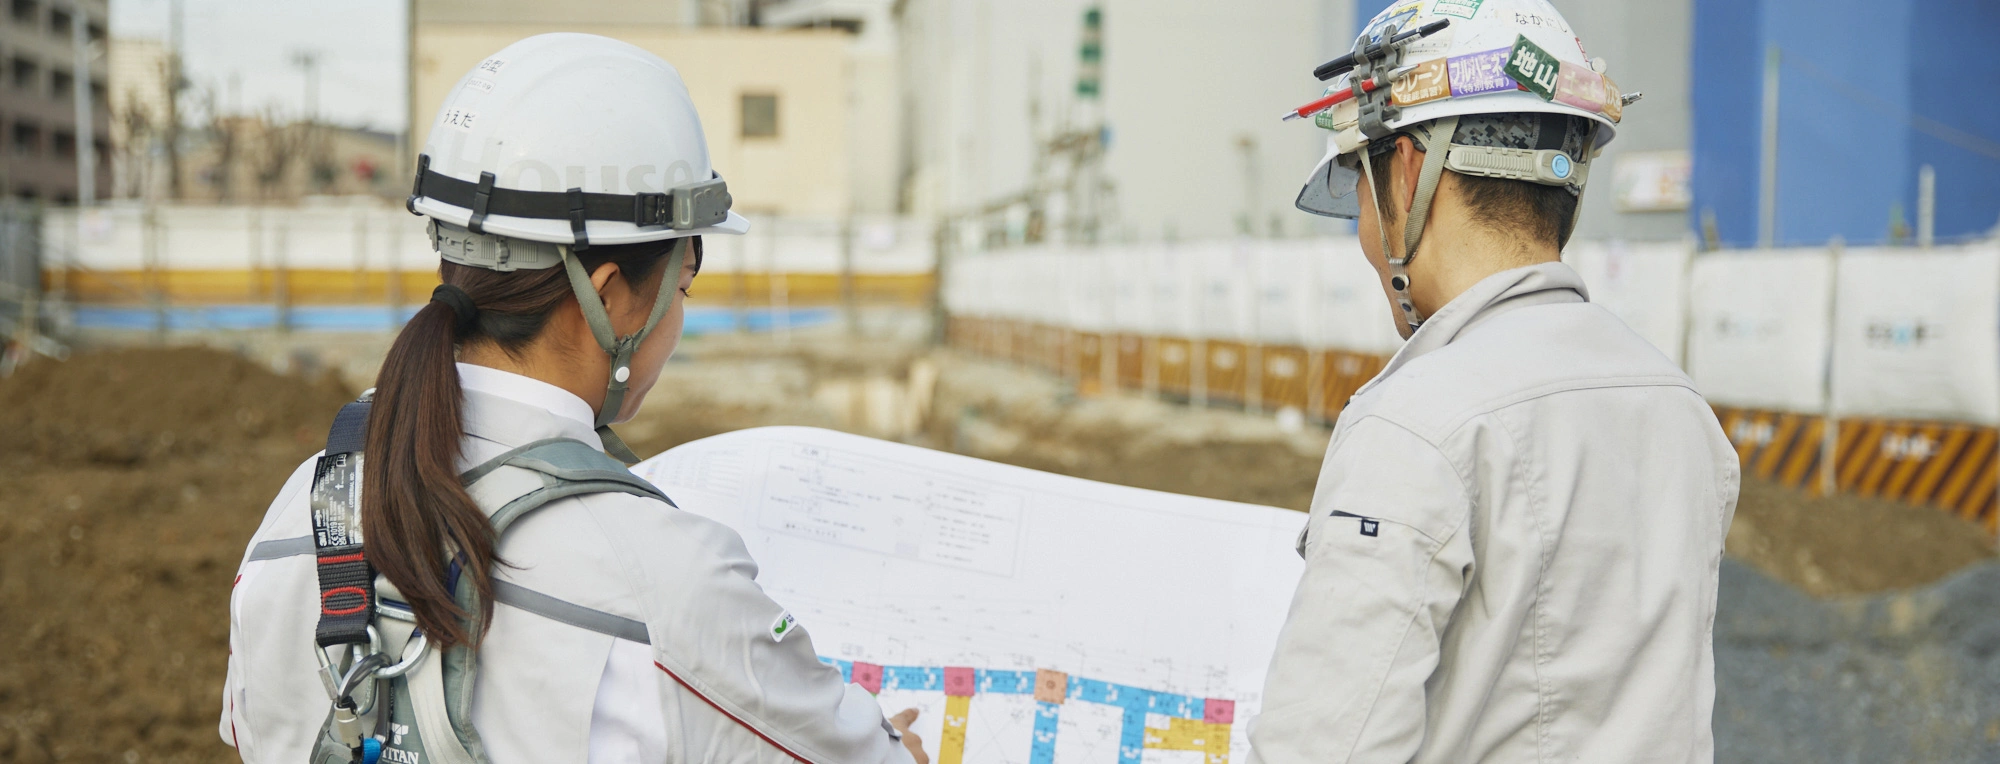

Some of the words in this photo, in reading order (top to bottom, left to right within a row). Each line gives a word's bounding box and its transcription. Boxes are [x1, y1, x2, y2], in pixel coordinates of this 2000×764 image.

[1512, 45, 1558, 94] 地山
[443, 109, 475, 129] うえだ
[318, 531, 327, 546] 3M
[382, 746, 419, 764] TITAN
